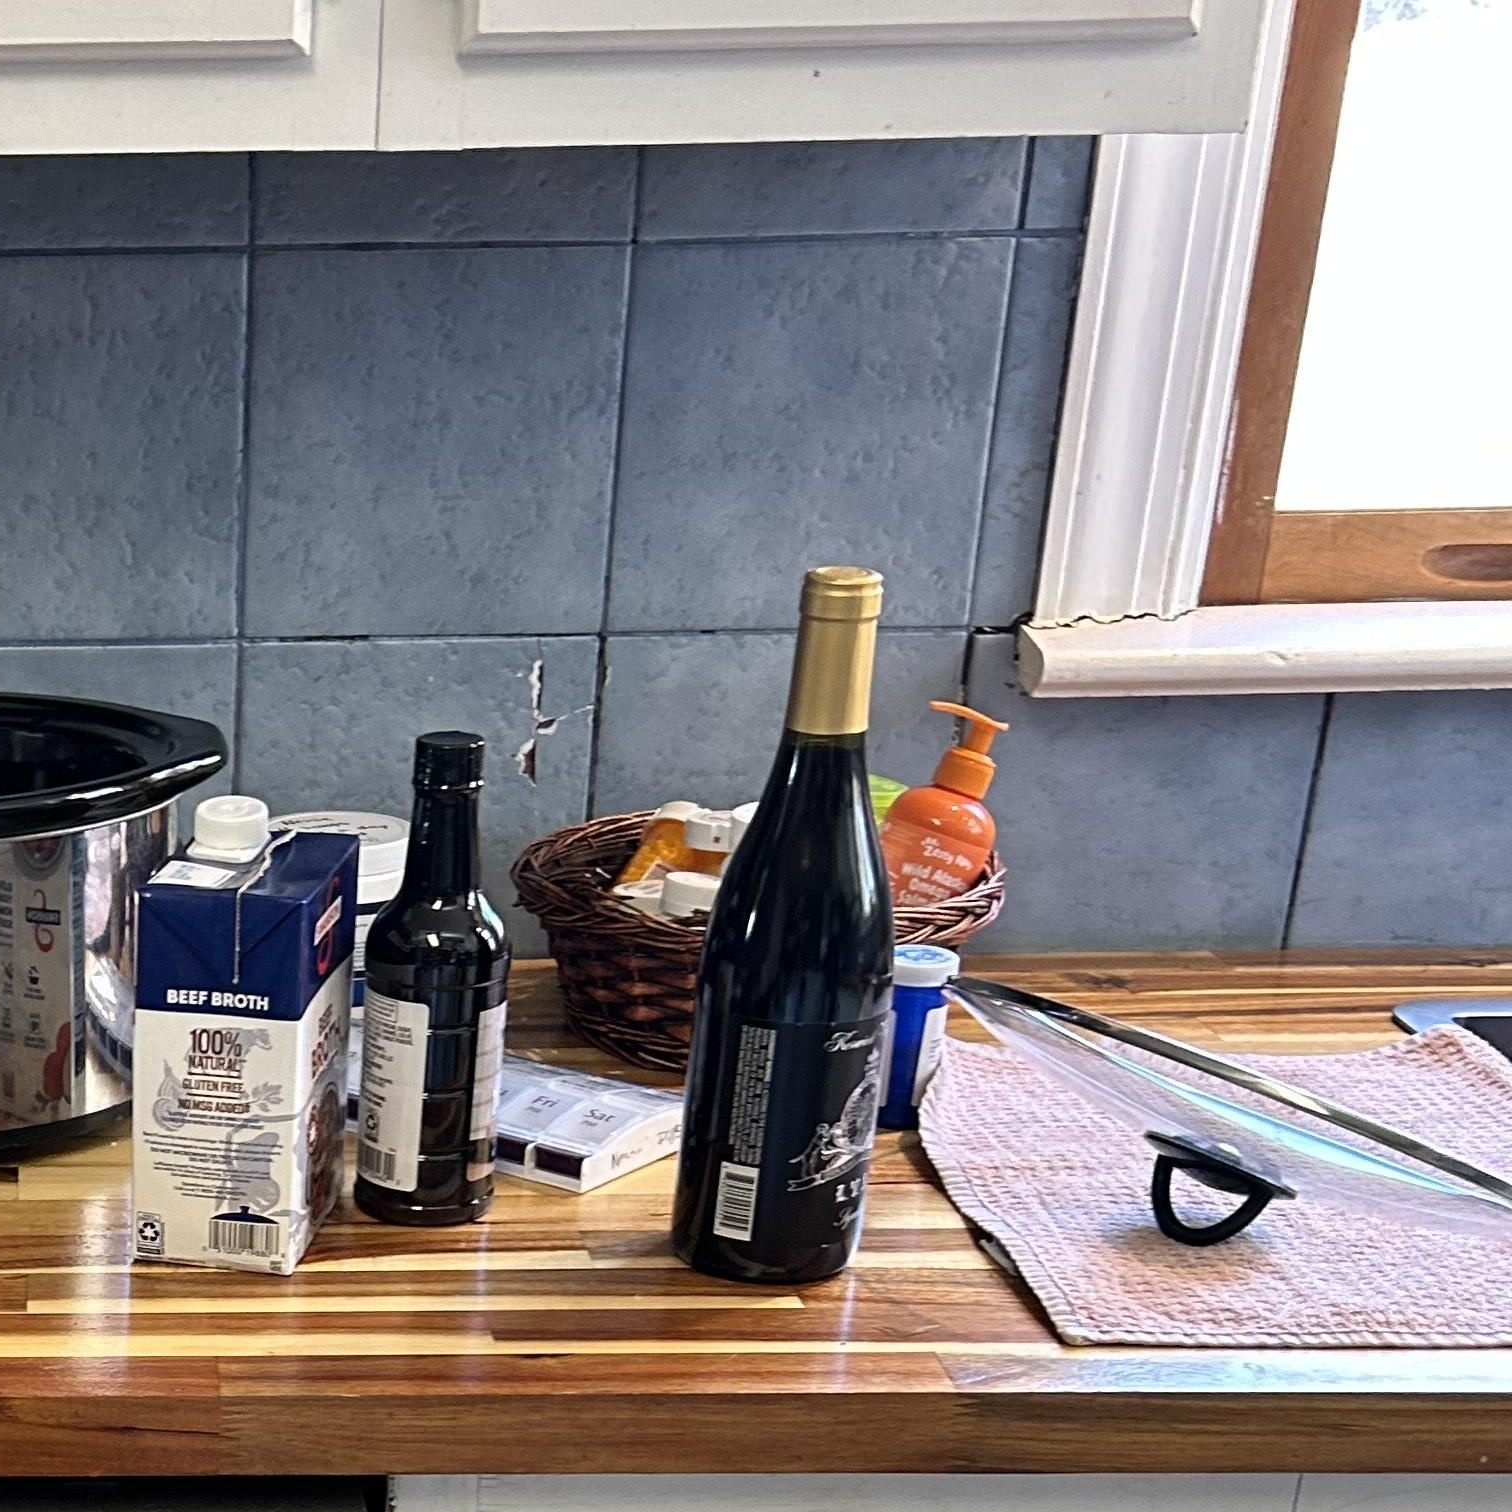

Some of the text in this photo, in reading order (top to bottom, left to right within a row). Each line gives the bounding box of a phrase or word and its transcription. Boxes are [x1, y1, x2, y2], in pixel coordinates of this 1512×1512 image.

[166, 988, 270, 1011] BEEF BROTH
[189, 1028, 242, 1057] 100%
[182, 1078, 245, 1094] GLUTEN FREE
[192, 1099, 214, 1112] MSG
[531, 1095, 561, 1108] Fri
[583, 1108, 616, 1122] Sat
